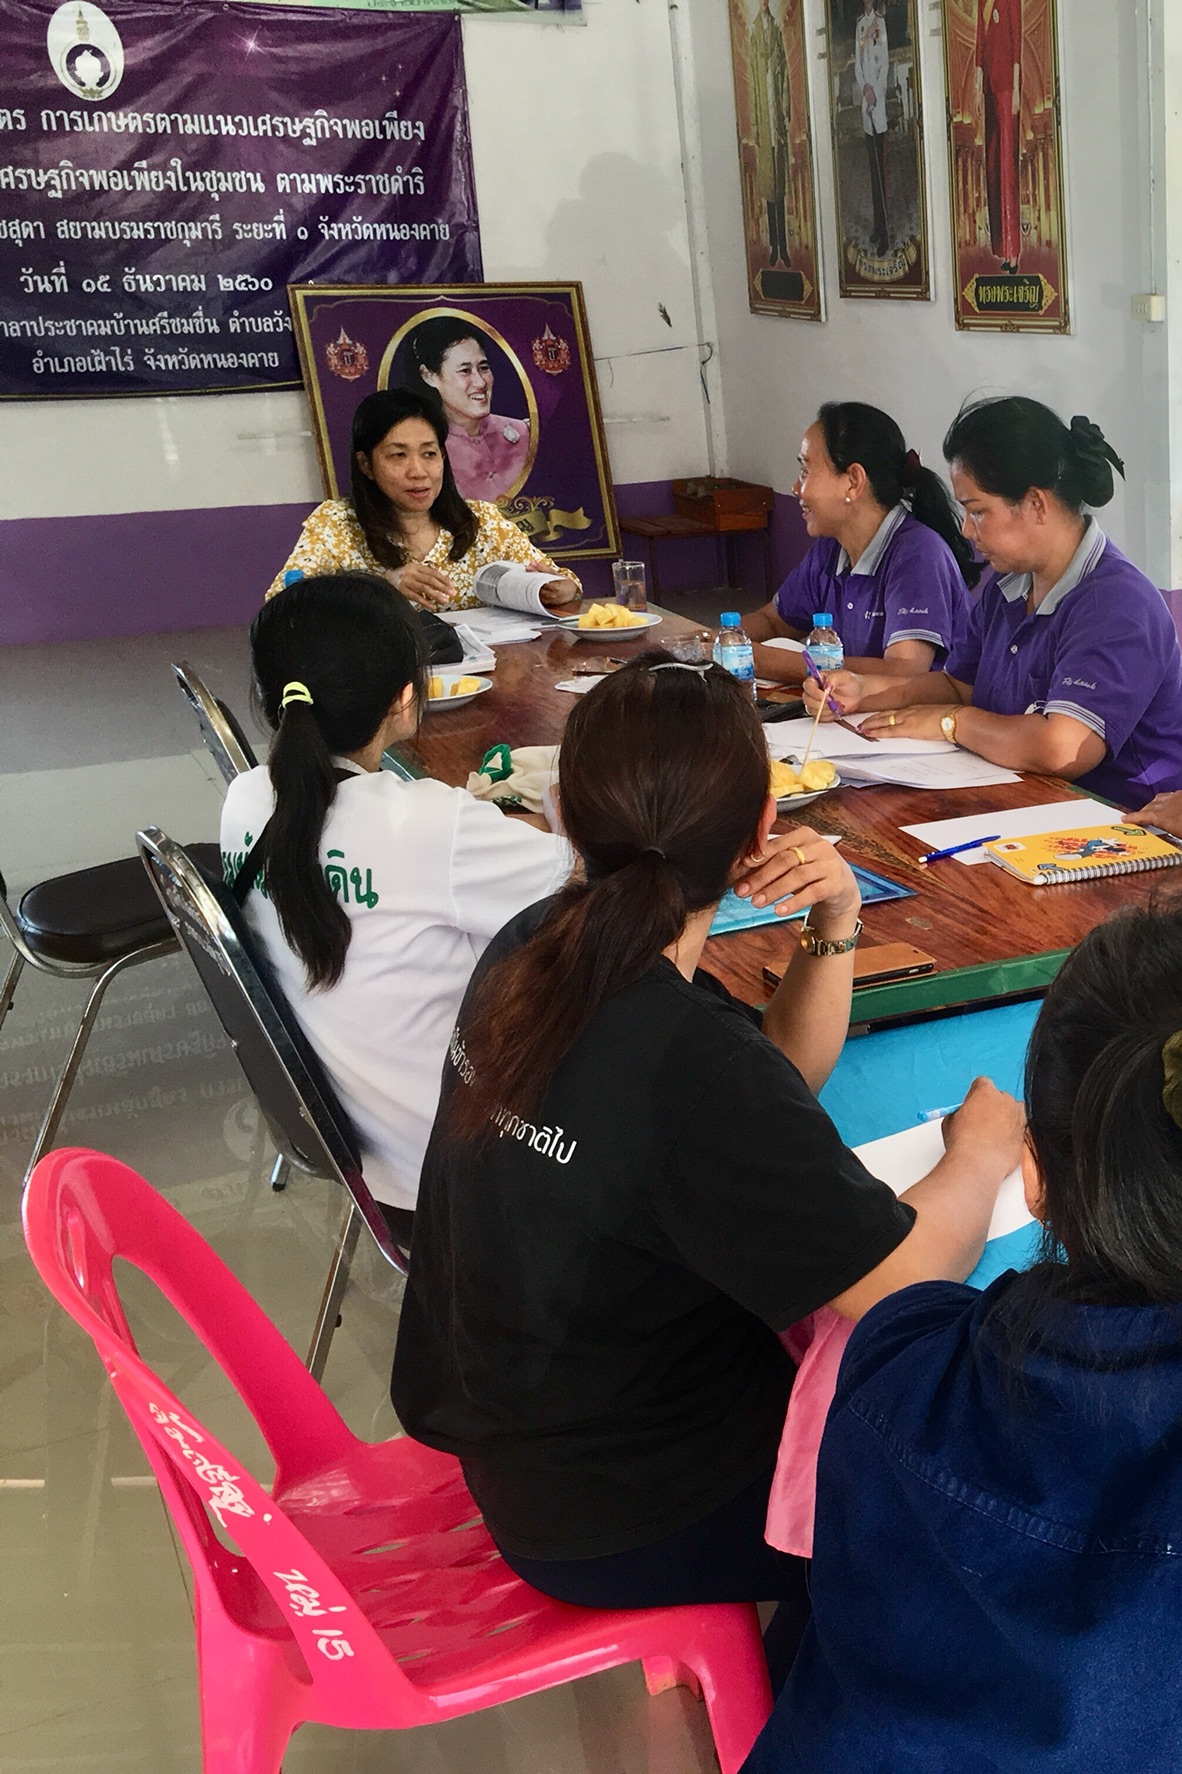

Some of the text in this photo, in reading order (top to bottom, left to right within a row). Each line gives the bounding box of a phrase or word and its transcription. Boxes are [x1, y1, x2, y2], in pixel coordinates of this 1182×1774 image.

[41, 109, 425, 146] การเกษตรตามแนวเศรษฐกิจพอเพียง
[276, 165, 425, 195] ตามพระราชดำริ
[56, 213, 222, 247] สยามบรมราชกุมารี
[233, 209, 287, 241] ระยะที่
[318, 215, 450, 241] จังหวัดหนองคาย
[20, 261, 68, 293] วันที่
[122, 267, 206, 293] ธันวาคม
[978, 278, 1040, 310] ทรงพระเจริญ
[32, 347, 279, 375] อำเภอเฝ้าไร่ จังหวัดหนองคาย
[312, 1629, 354, 1660] 15
